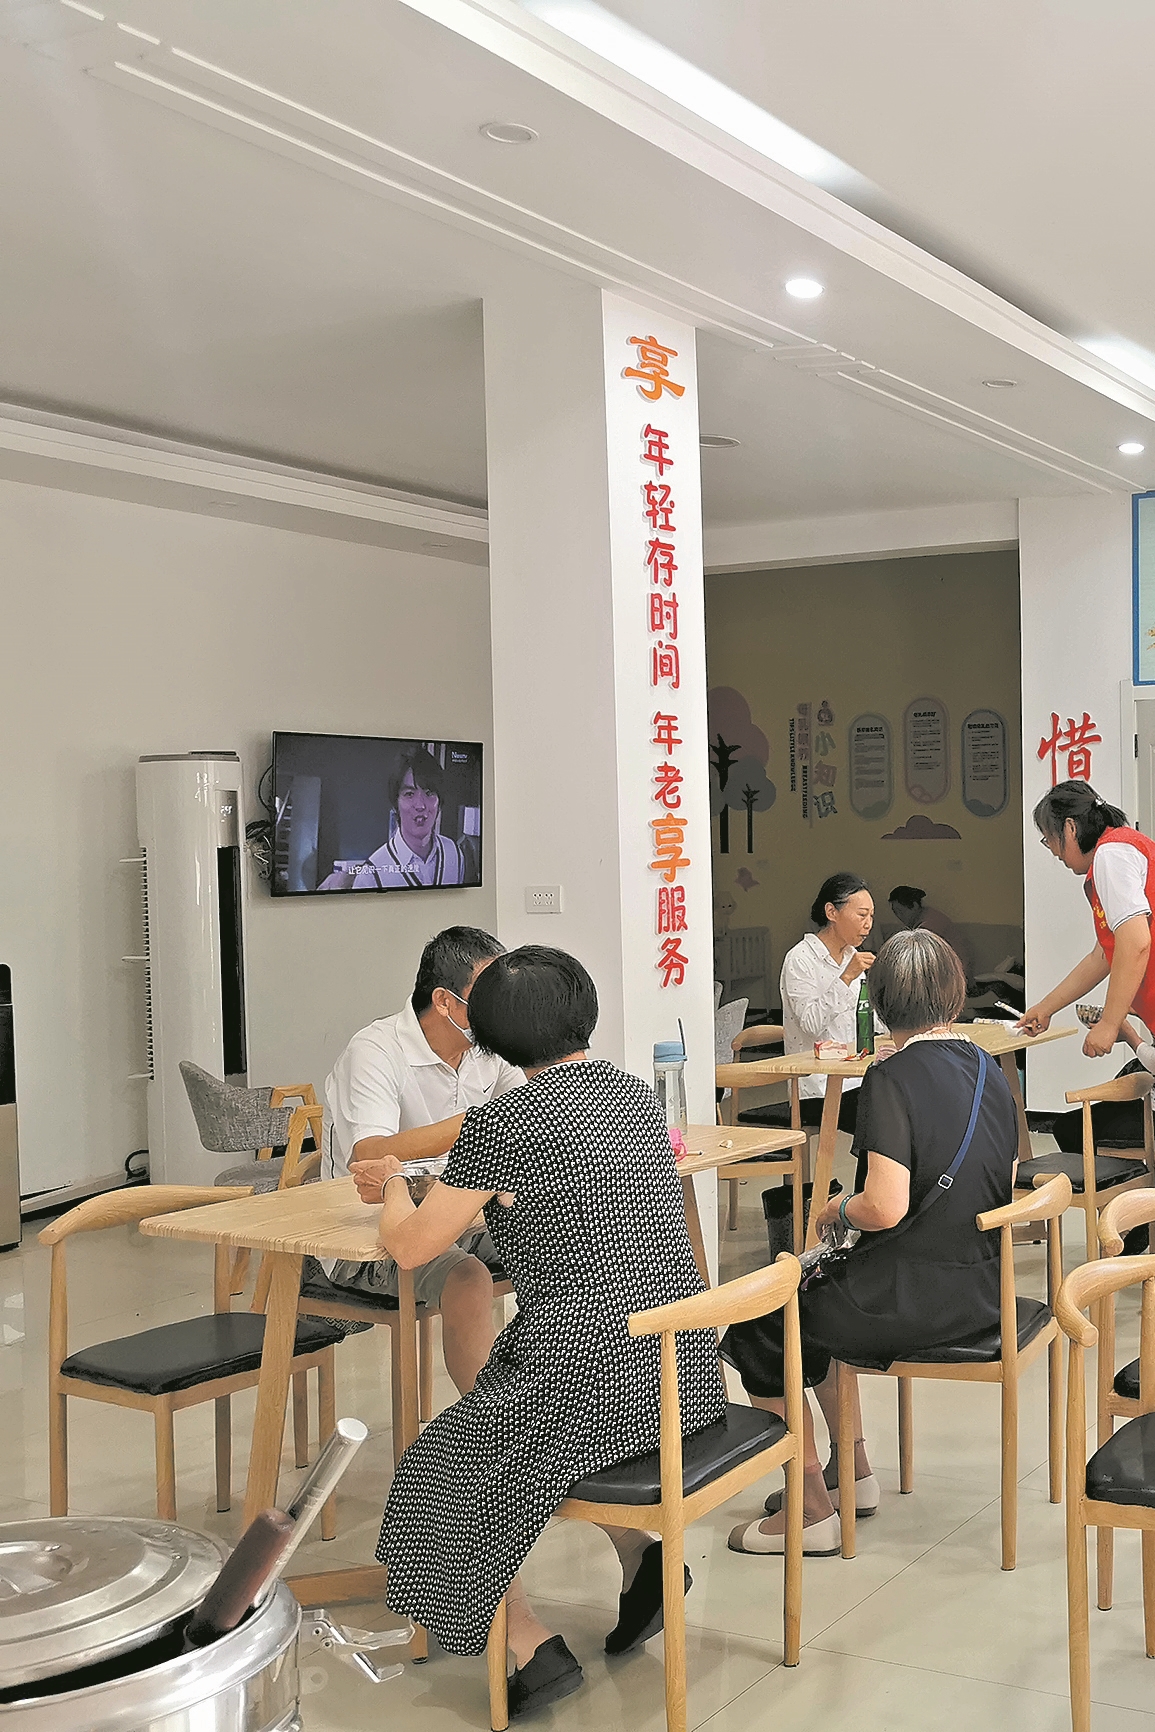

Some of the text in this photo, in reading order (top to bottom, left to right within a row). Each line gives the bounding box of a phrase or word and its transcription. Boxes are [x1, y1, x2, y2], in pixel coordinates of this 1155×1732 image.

[625, 335, 684, 402] 享
[640, 424, 681, 690] 年轻存时间
[1037, 712, 1102, 787] 惜
[649, 711, 692, 988] 年老享服务
